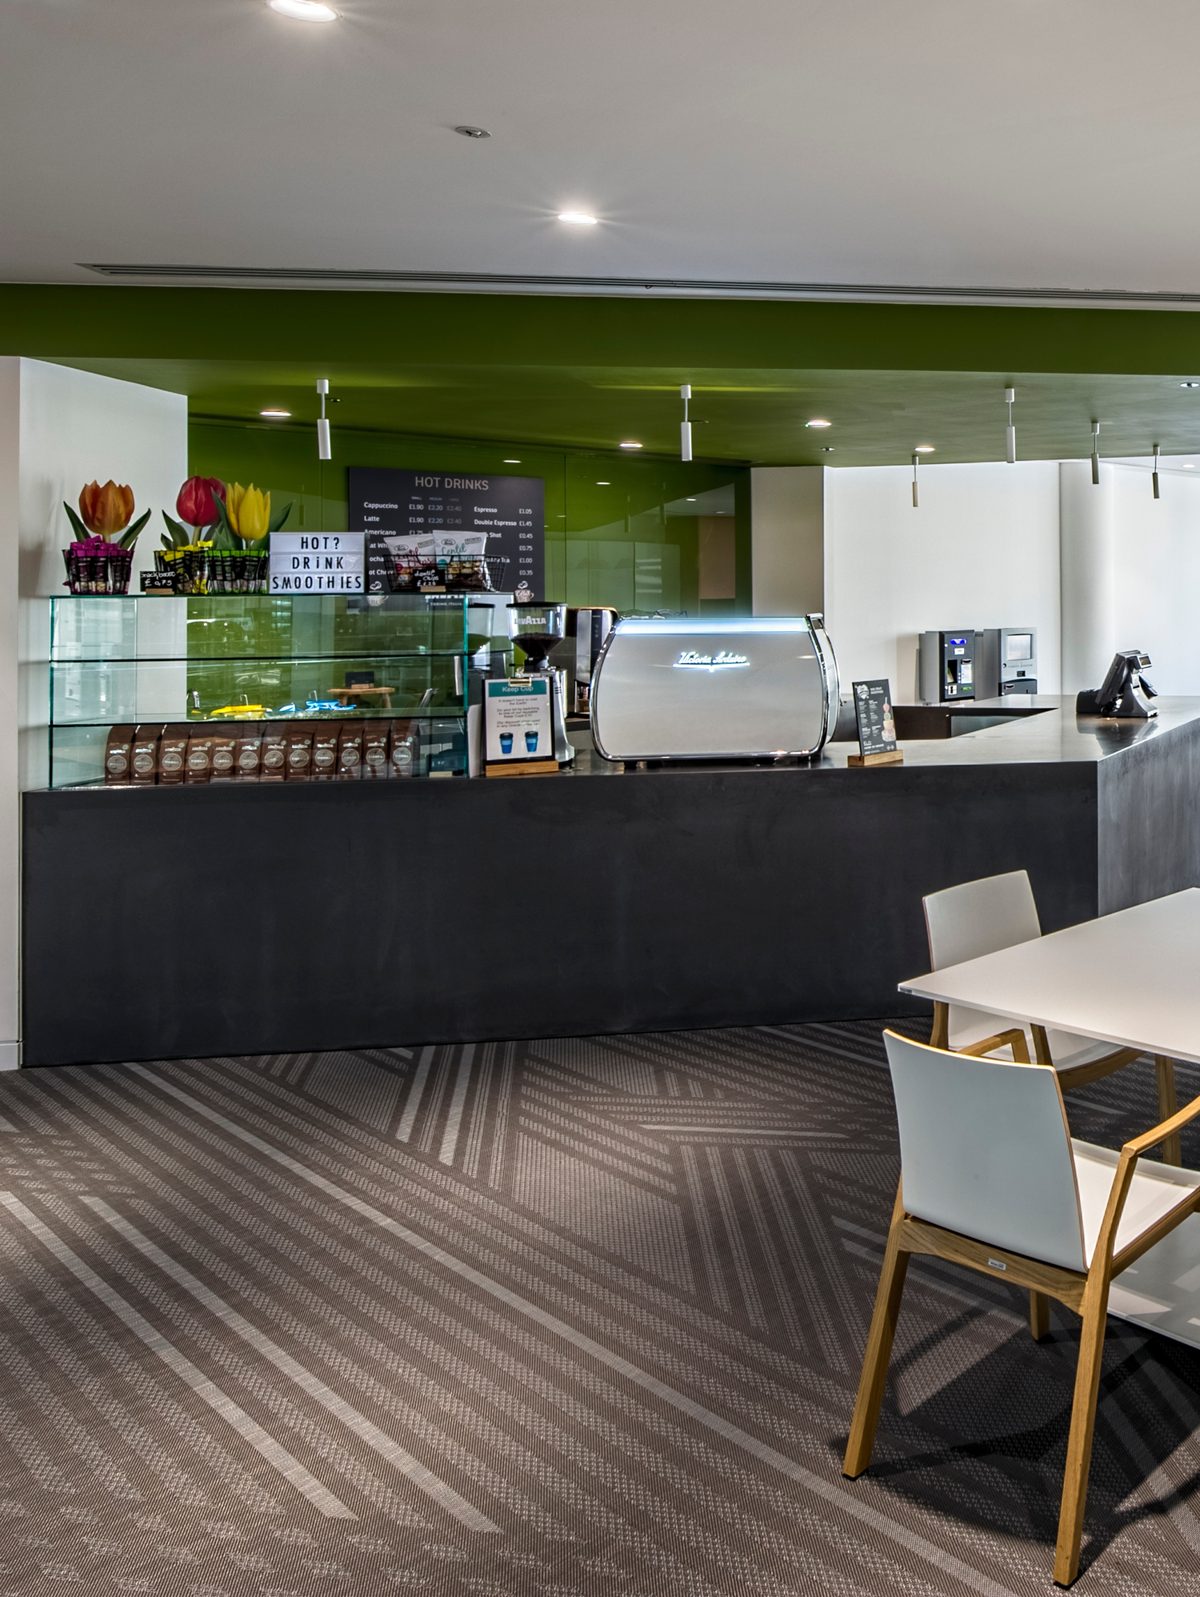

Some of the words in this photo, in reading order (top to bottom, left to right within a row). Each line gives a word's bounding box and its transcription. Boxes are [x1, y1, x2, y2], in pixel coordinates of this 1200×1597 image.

[415, 476, 440, 488] HOT
[444, 478, 489, 491] DRINKS
[363, 501, 398, 510] Cappuccino
[300, 536, 340, 550] HOT?
[272, 575, 362, 590] SMOOTHIES
